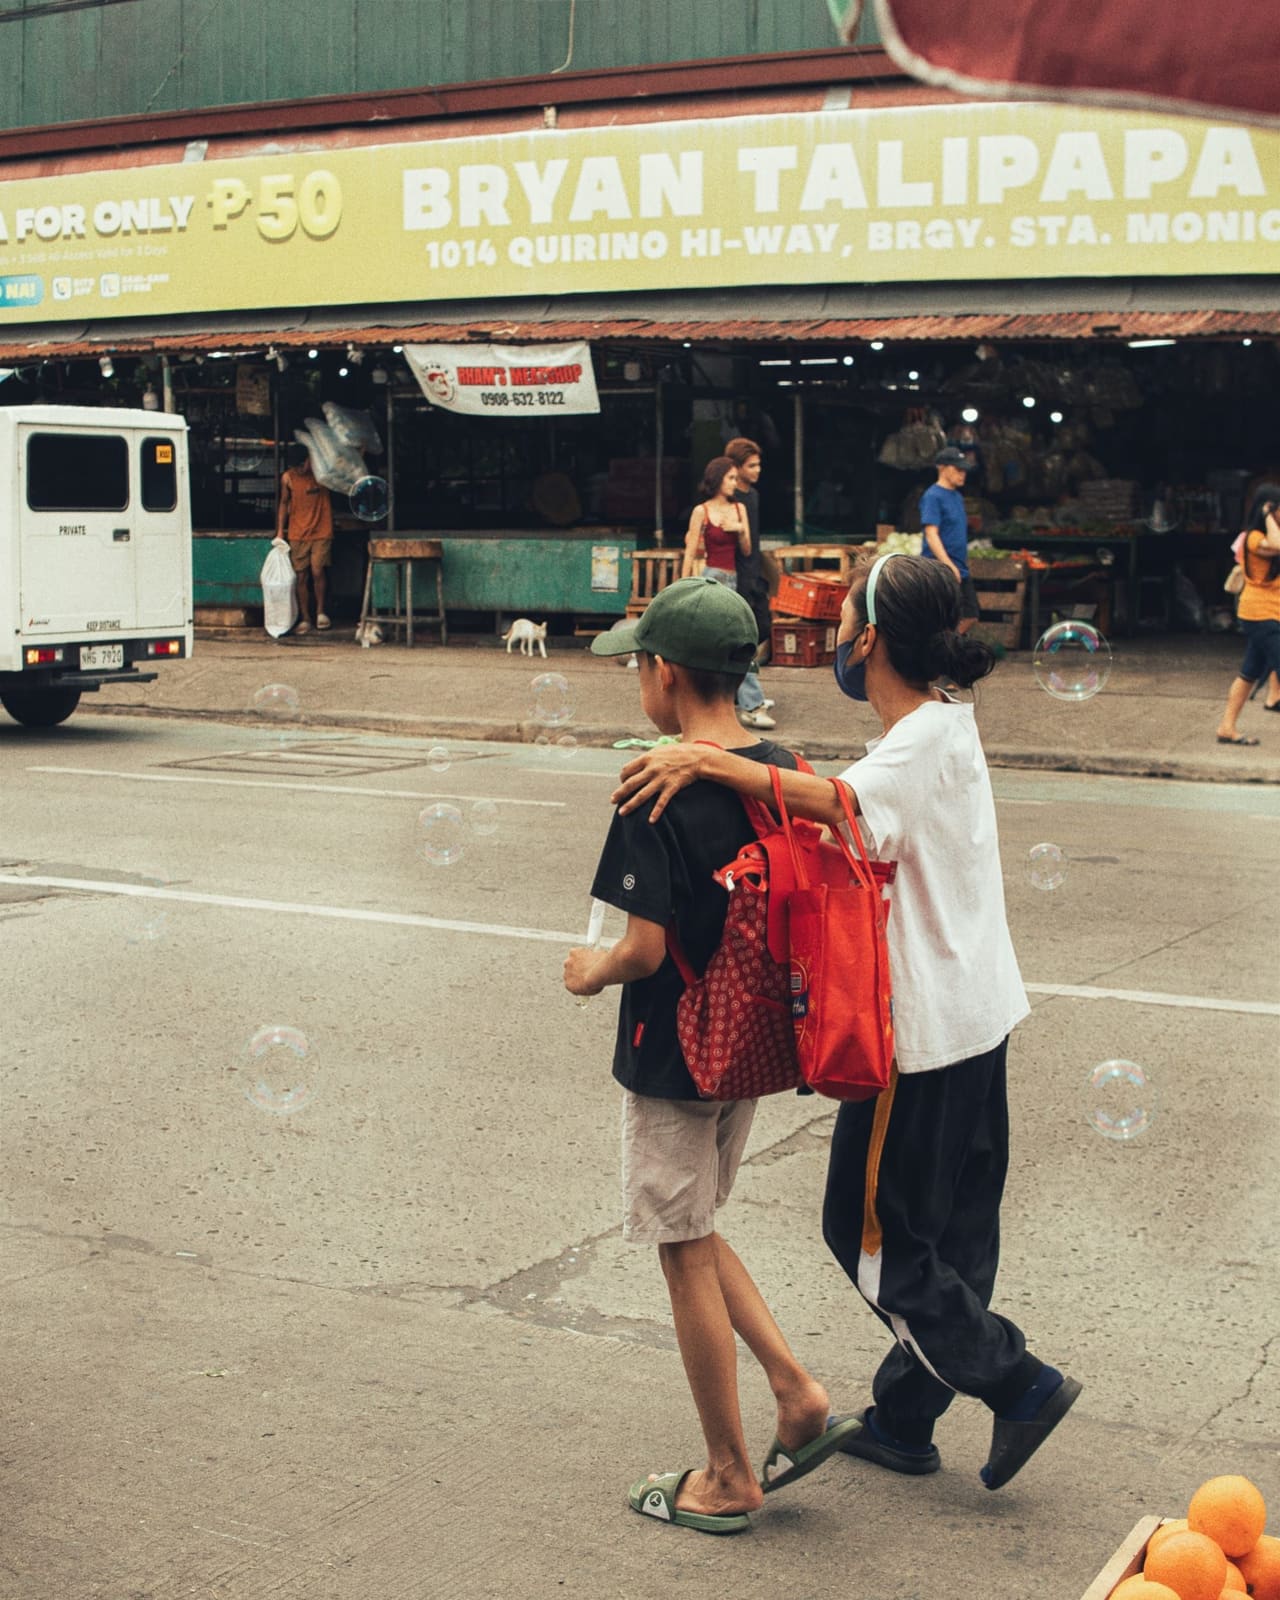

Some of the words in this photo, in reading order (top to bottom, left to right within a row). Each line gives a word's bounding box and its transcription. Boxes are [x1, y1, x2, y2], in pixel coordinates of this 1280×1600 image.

[403, 150, 704, 231] BRYAN
[738, 127, 1267, 213] TALIPAPA
[16, 205, 85, 243] FOR
[93, 195, 194, 235] ONLY
[425, 239, 497, 268] 1014
[508, 230, 668, 268] QUIRINO
[682, 223, 852, 258] HI-WAY,
[868, 218, 993, 251] BRGY.
[1010, 215, 1112, 247] STA.
[1126, 208, 1280, 244] MONIC
[481, 391, 565, 406] 0908-632-8122
[59, 525, 87, 536] PRIVATE
